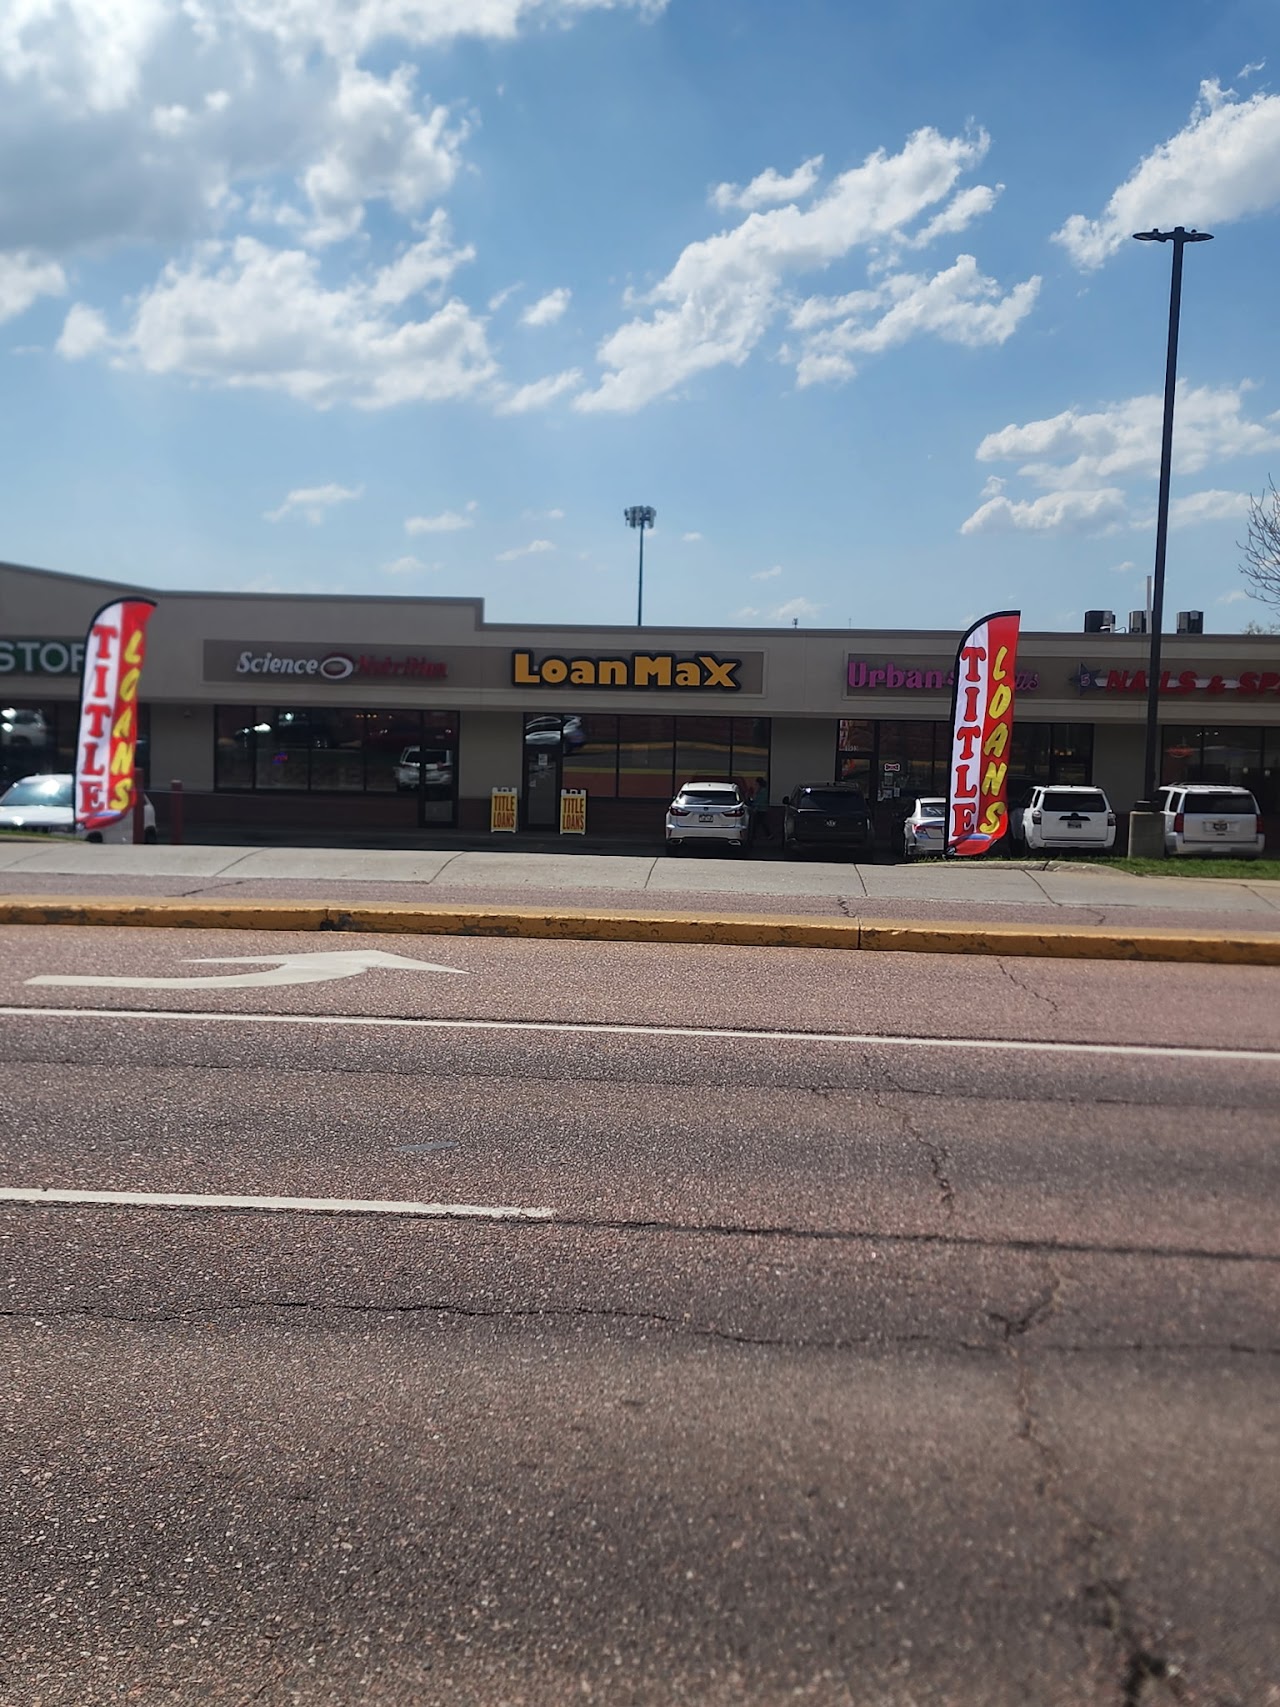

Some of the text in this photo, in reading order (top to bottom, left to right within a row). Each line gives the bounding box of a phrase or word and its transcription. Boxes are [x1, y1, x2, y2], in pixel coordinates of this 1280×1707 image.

[236, 651, 318, 675] Science
[848, 661, 943, 689] Urban
[1105, 669, 1280, 695] NALS & SP
[80, 624, 118, 814] TITLE
[110, 629, 142, 811] LOANS
[952, 646, 987, 837] TITLE
[979, 645, 1012, 834] LOANS
[494, 795, 516, 812] TITLE
[562, 797, 585, 814] TITLE
[493, 812, 515, 828] LOANS
[562, 814, 585, 830] LOANS
